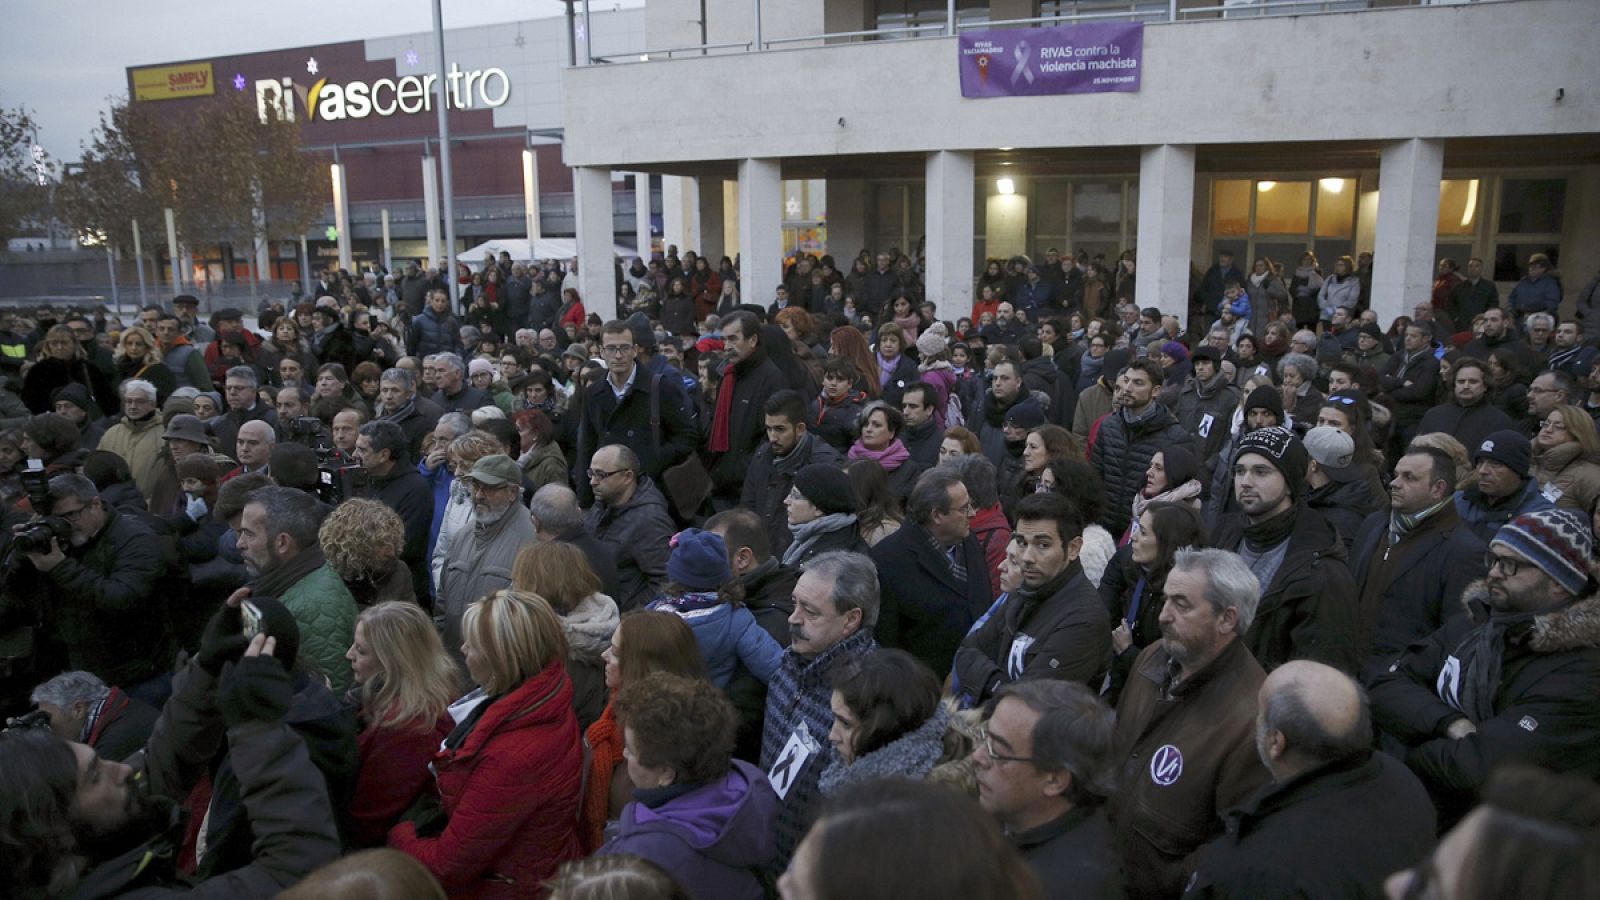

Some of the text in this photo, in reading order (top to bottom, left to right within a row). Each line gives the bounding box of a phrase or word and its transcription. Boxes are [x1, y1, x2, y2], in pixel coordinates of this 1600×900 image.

[1040, 43, 1120, 59] RIVAS contra la
[1040, 57, 1137, 72] violencia machista
